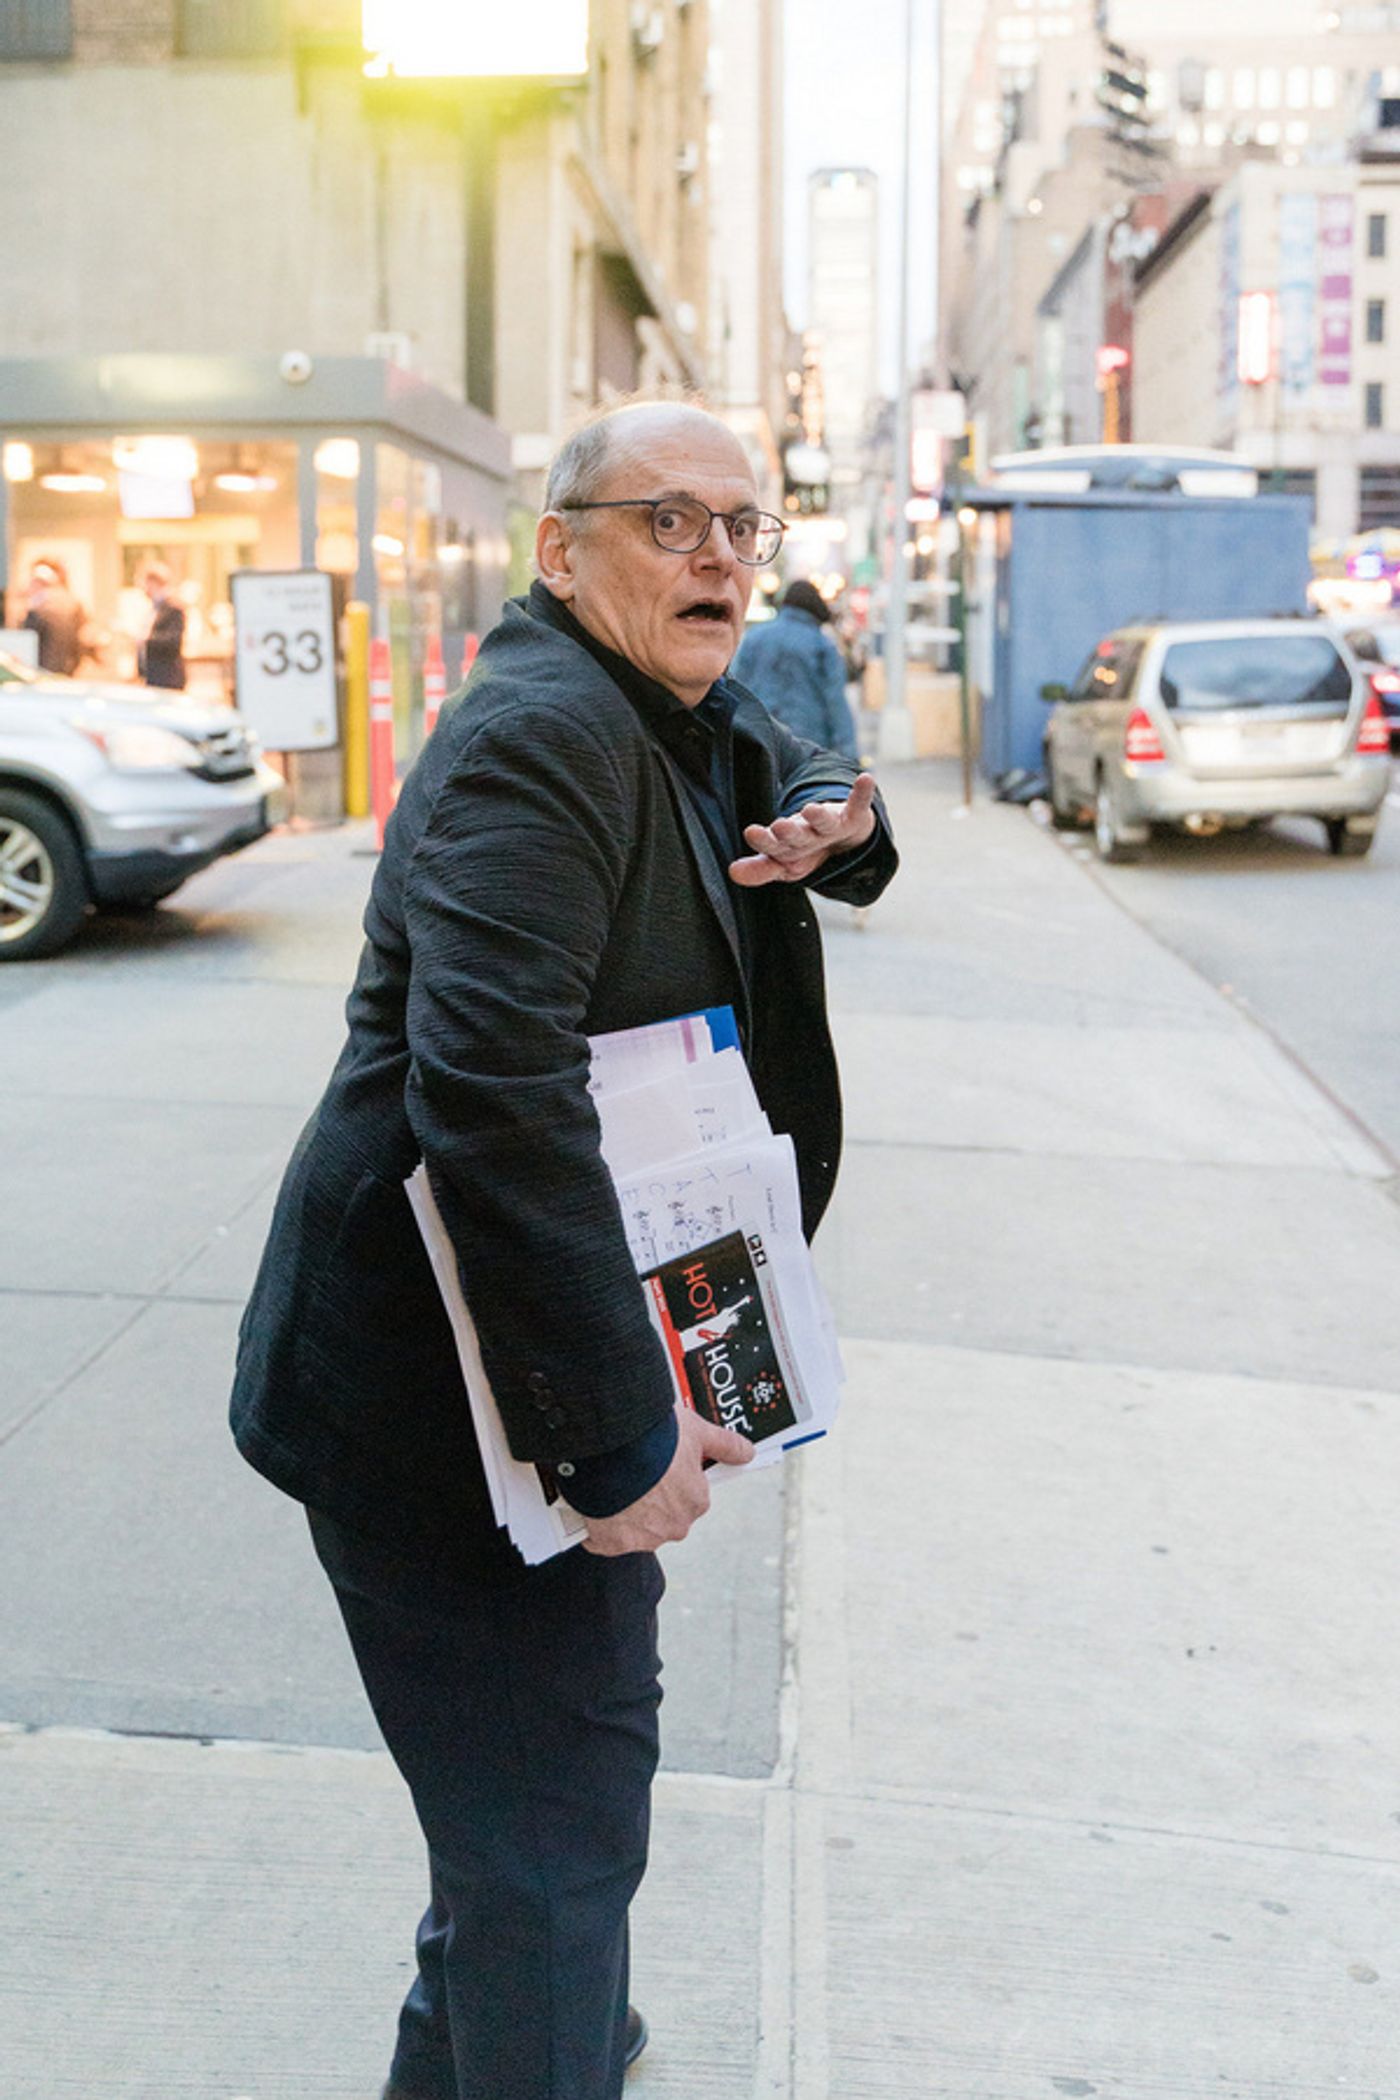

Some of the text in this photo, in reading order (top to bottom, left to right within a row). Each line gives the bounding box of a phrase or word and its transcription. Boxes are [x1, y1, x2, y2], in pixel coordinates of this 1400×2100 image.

[262, 630, 322, 676] 33
[682, 1262, 718, 1320] HOT
[705, 1344, 750, 1432] HOUSE
